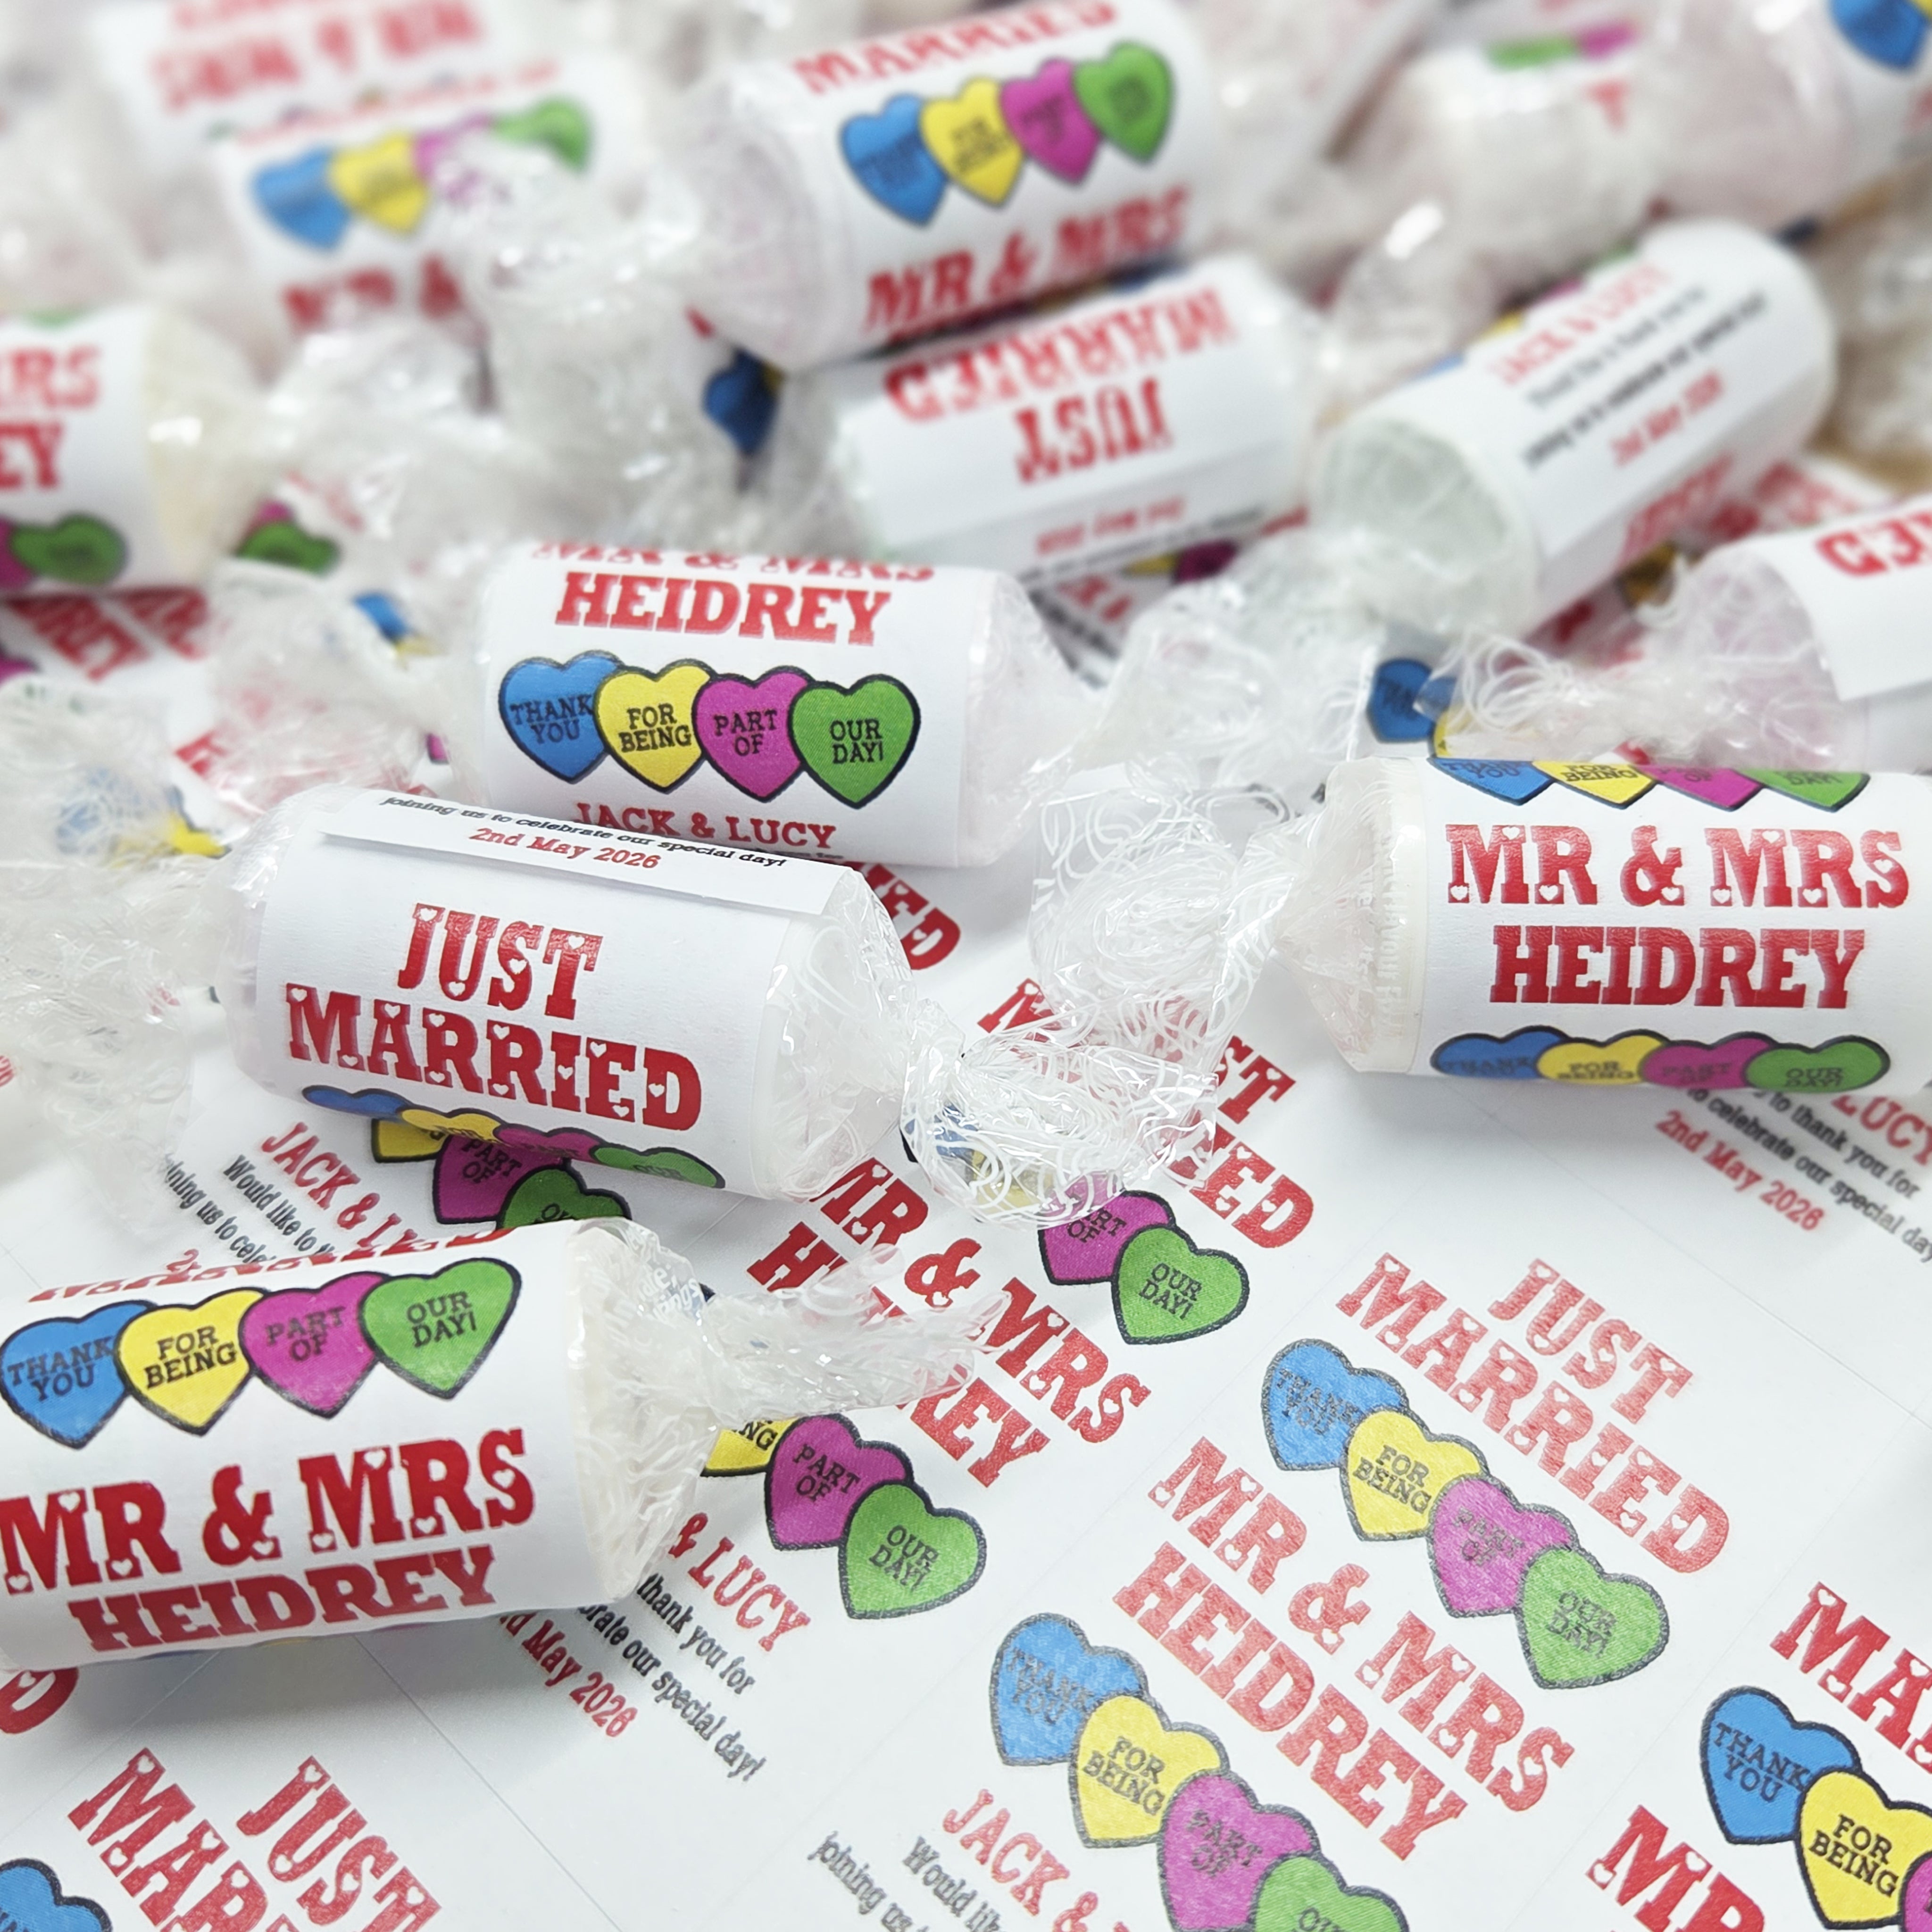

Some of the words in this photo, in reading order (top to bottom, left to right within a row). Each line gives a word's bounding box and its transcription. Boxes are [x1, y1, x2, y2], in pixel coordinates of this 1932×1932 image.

[556, 572, 891, 646] HEIDREY
[510, 694, 594, 724] THANK
[532, 718, 580, 744] YOU
[626, 704, 676, 730] FOR
[714, 709, 778, 735] PART
[830, 718, 881, 741] OUR
[620, 726, 692, 753] BEING
[735, 733, 763, 756] OF
[833, 740, 883, 764] DAY!
[379, 797, 456, 817] joining
[461, 808, 486, 820] us
[491, 814, 513, 823] to
[516, 817, 614, 839] celebrate
[616, 832, 655, 844] our
[658, 838, 735, 858] special
[739, 851, 786, 867] day!
[469, 828, 525, 848] 2nd
[527, 835, 590, 859] May
[593, 847, 661, 869] 2026
[575, 802, 680, 838] JACK
[691, 812, 716, 838] &
[729, 817, 837, 848] LUCY
[1446, 823, 1597, 906] MR
[1620, 825, 1685, 907] &
[1706, 827, 1909, 908] MRS
[398, 903, 603, 1020] JUST
[1490, 925, 1865, 1009] HEIDREY
[284, 983, 703, 1131] MARRIED
[260, 1122, 361, 1211] JACK
[337, 1192, 381, 1230] &
[460, 1138, 522, 1177] PART
[463, 1161, 495, 1184] OF
[1654, 1108, 1699, 1153] 2nd
[1701, 1141, 1763, 1192] May
[1759, 1179, 1825, 1231] 2026
[1707, 1098, 1795, 1160] celebrate
[1795, 1156, 1832, 1185] our
[1829, 1181, 1905, 1234] special
[1791, 1105, 1848, 1151] thank
[1844, 1144, 1890, 1178] you
[1887, 1169, 1921, 1199] for
[197, 1200, 224, 1225] us
[215, 1216, 238, 1240] to
[223, 1154, 282, 1211] Would
[266, 1199, 302, 1235] like
[293, 1227, 317, 1251] to
[1066, 1219, 1099, 1244] OF
[406, 1290, 471, 1323] OUR
[808, 1157, 929, 1246] MR
[905, 1237, 981, 1309] &
[967, 1276, 1151, 1444] MRS
[1137, 1284, 1192, 1321] DAY!
[1150, 1261, 1203, 1302] OUR
[158, 1325, 219, 1360] FOR
[266, 1305, 347, 1344] PART
[289, 1333, 329, 1363] OF
[411, 1312, 477, 1349] DAY!
[1487, 1257, 1693, 1424] JUST
[8, 1333, 116, 1388] THANK
[33, 1367, 94, 1402] YOU
[144, 1342, 239, 1390] BEING
[1336, 1251, 1730, 1573] MARRIED
[793, 1443, 860, 1496] PART
[796, 1474, 831, 1503] OF
[1353, 1456, 1433, 1515] BEING
[1375, 1444, 1429, 1488] FOR
[0, 1480, 181, 1595] MR
[202, 1464, 282, 1566] &
[299, 1428, 536, 1553] MRS
[868, 1544, 927, 1593] DAY!
[885, 1524, 941, 1569] OUR
[67, 1545, 497, 1652] HEIDREY
[688, 1537, 811, 1651] LUCY
[636, 1573, 693, 1634] thank
[679, 1625, 729, 1671] you
[719, 1656, 756, 1695] for
[1149, 1436, 1307, 1595] MR
[1288, 1563, 1372, 1655] &
[1356, 1609, 1575, 1813] MRS
[521, 1618, 583, 1687] May
[568, 1671, 639, 1738] 2026
[1113, 1540, 1468, 1861] HEIDREY
[622, 1639, 662, 1678] our
[651, 1670, 727, 1743] special
[714, 1730, 766, 1782] day!
[1082, 1750, 1167, 1816] BEING
[1111, 1736, 1166, 1786] FOR
[1711, 1722, 1813, 1792] THANK
[1724, 1754, 1785, 1803] YOU
[236, 1755, 442, 1932] JUST
[942, 1788, 1071, 1917] JACK
[1808, 1829, 1899, 1899] BEING
[1832, 1813, 1893, 1865] FOR
[807, 1830, 887, 1916] joining
[902, 1835, 978, 1918] Would
